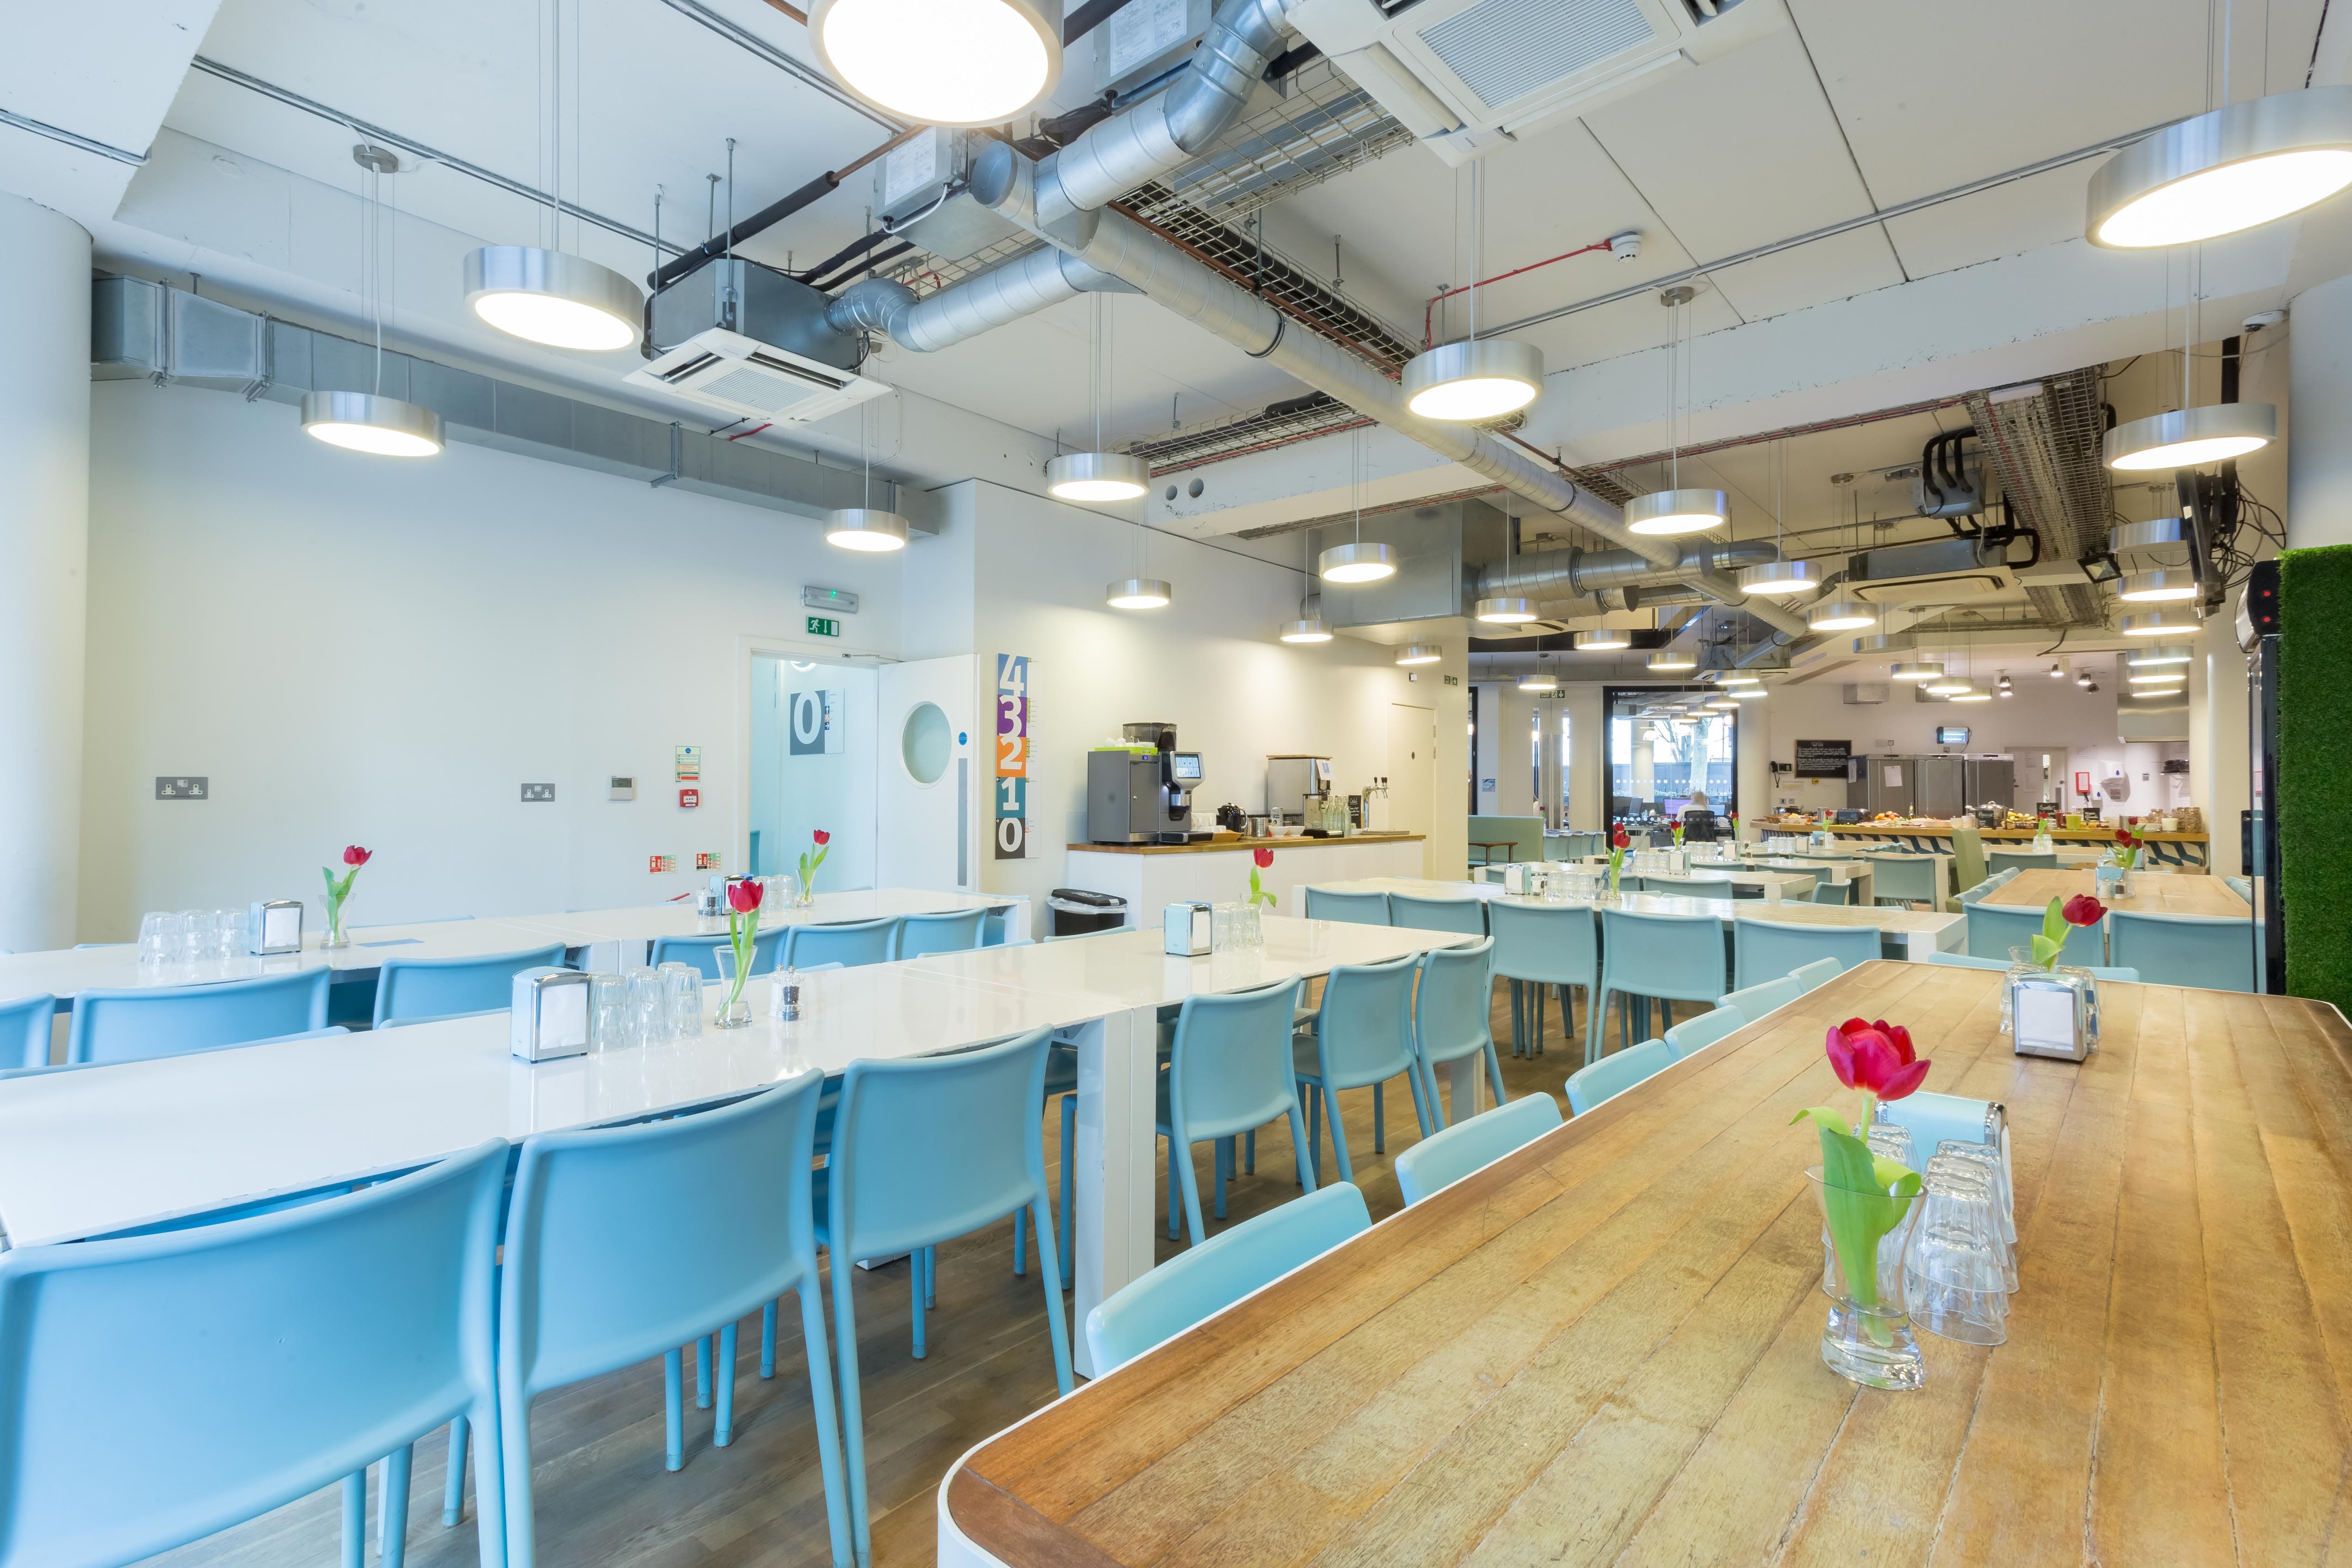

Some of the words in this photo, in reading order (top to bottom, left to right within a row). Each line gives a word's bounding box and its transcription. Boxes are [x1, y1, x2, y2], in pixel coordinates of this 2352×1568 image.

[999, 654, 1024, 697] 4
[794, 690, 822, 745] 0
[999, 694, 1022, 737] 3
[1000, 736, 1022, 770] 2
[1001, 777, 1020, 811] 1
[999, 818, 1023, 852] 0
